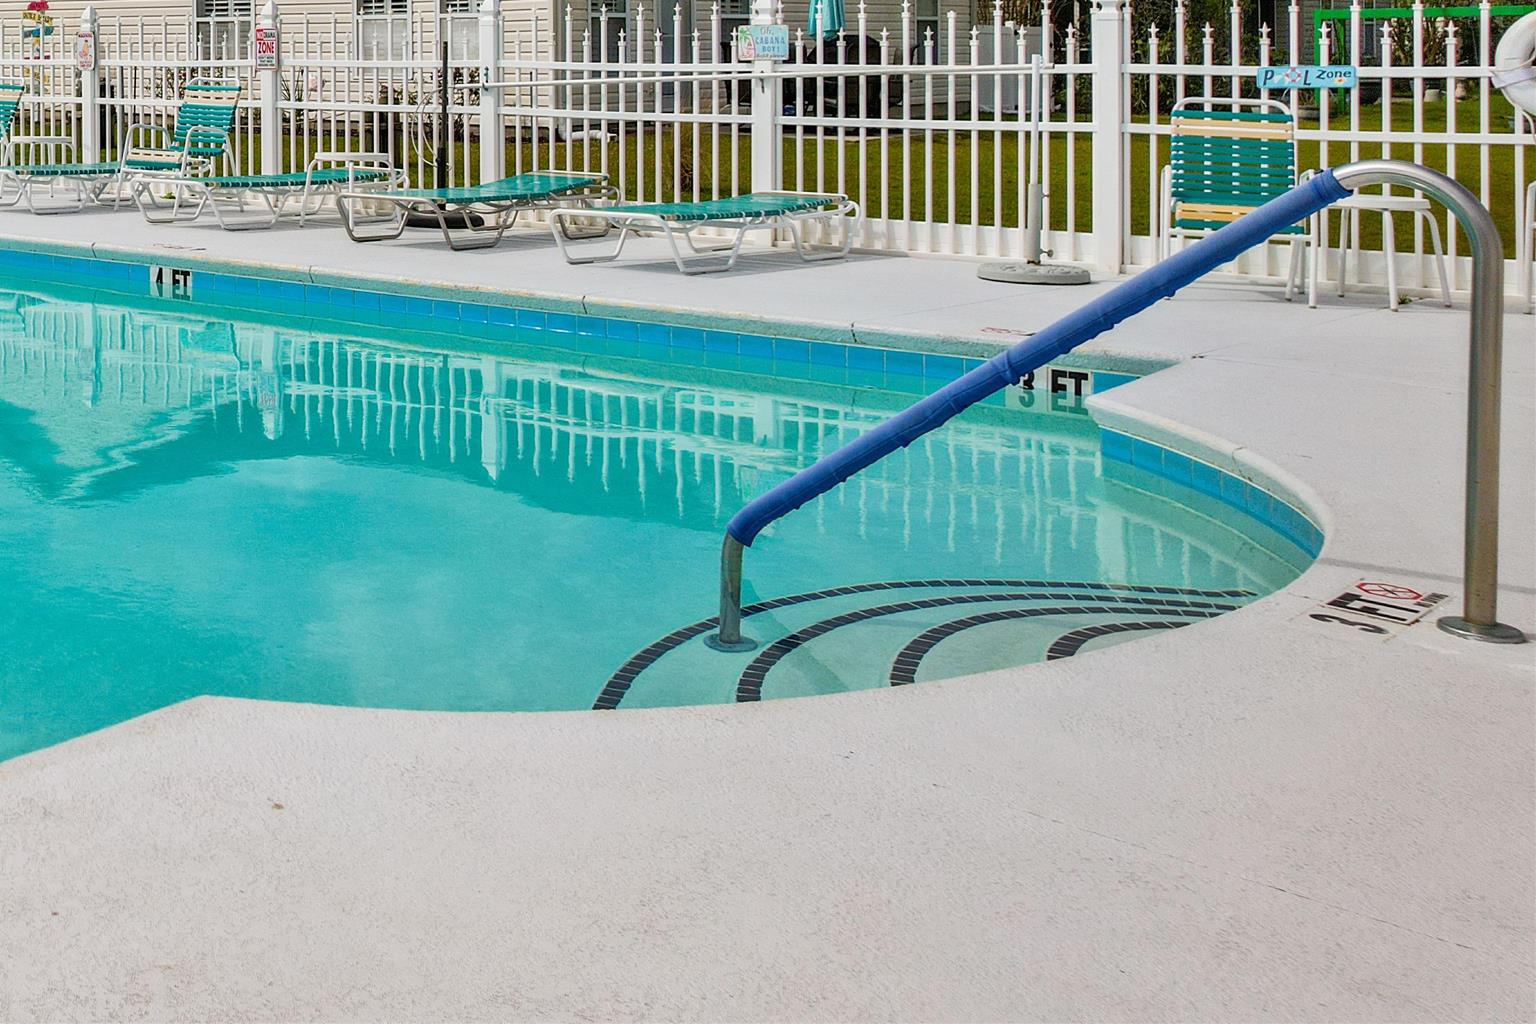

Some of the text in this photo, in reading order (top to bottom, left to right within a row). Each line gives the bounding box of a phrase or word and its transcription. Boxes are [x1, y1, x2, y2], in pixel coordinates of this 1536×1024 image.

[258, 41, 274, 54] ZONE
[755, 37, 785, 45] CABANA
[1316, 69, 1352, 80] Zone
[172, 268, 191, 287] FT
[1051, 369, 1089, 397] FT
[1326, 592, 1421, 622] FT
[1309, 613, 1391, 635] 3
